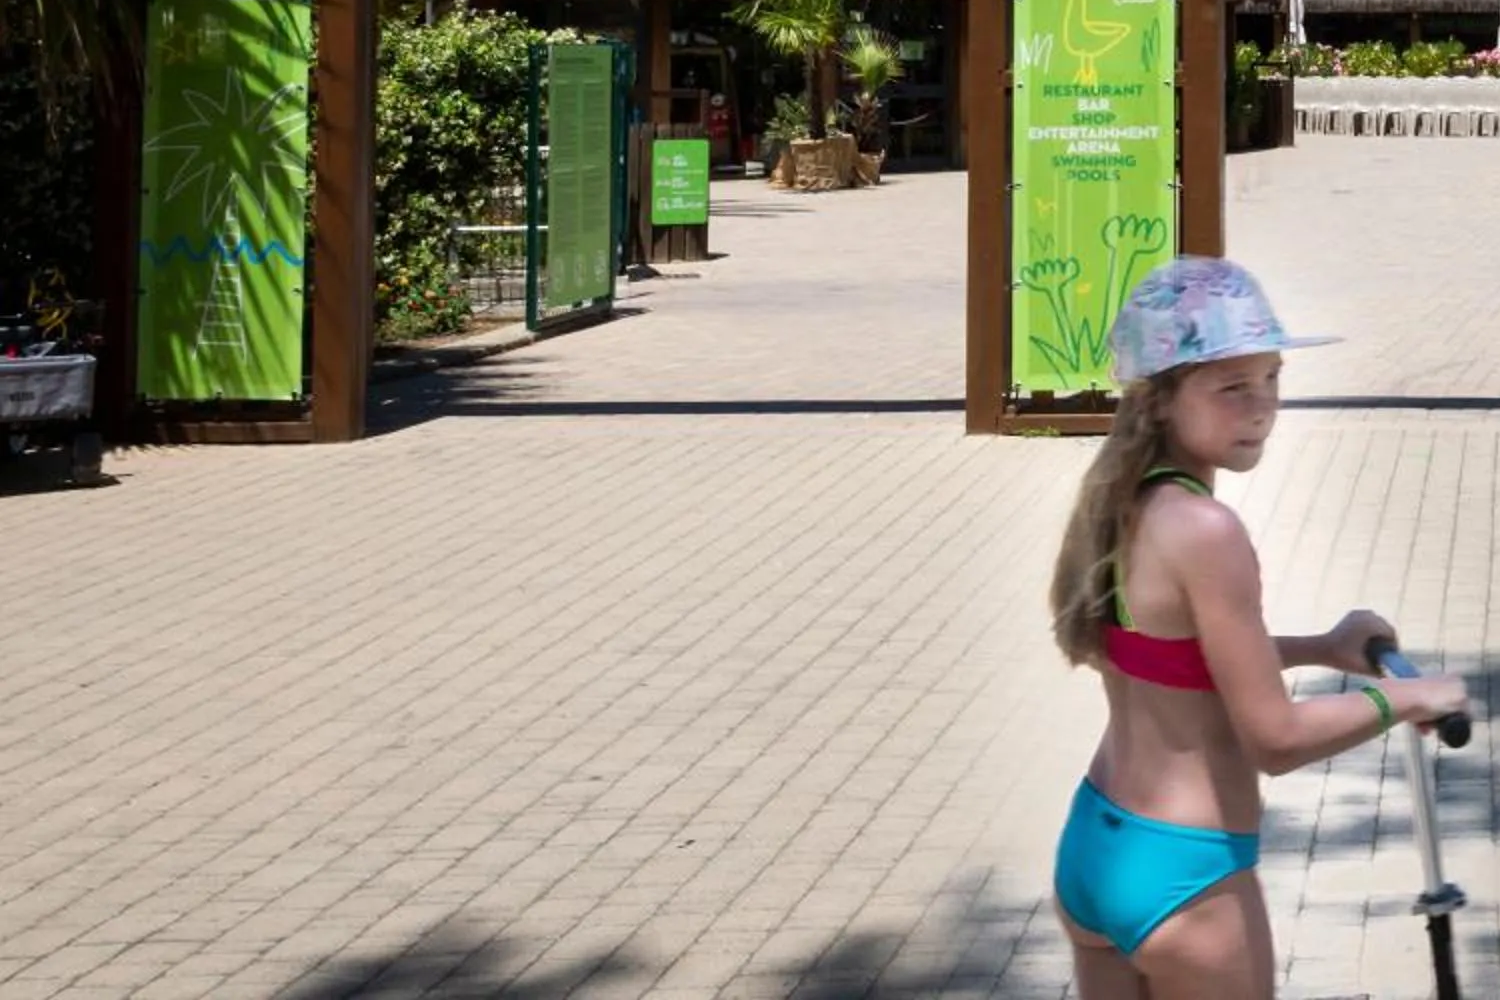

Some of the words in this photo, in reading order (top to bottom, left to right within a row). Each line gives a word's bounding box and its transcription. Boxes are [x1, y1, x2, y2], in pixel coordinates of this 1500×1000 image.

[1043, 85, 1144, 96] RESTAURANT
[1077, 98, 1110, 111] BAR
[1072, 113, 1117, 125] SHOP
[1028, 126, 1160, 140] ENTERTAINMENT
[1066, 141, 1121, 154] ARENA
[1053, 155, 1137, 167] SWIMMING
[1066, 170, 1121, 181] POOLS
